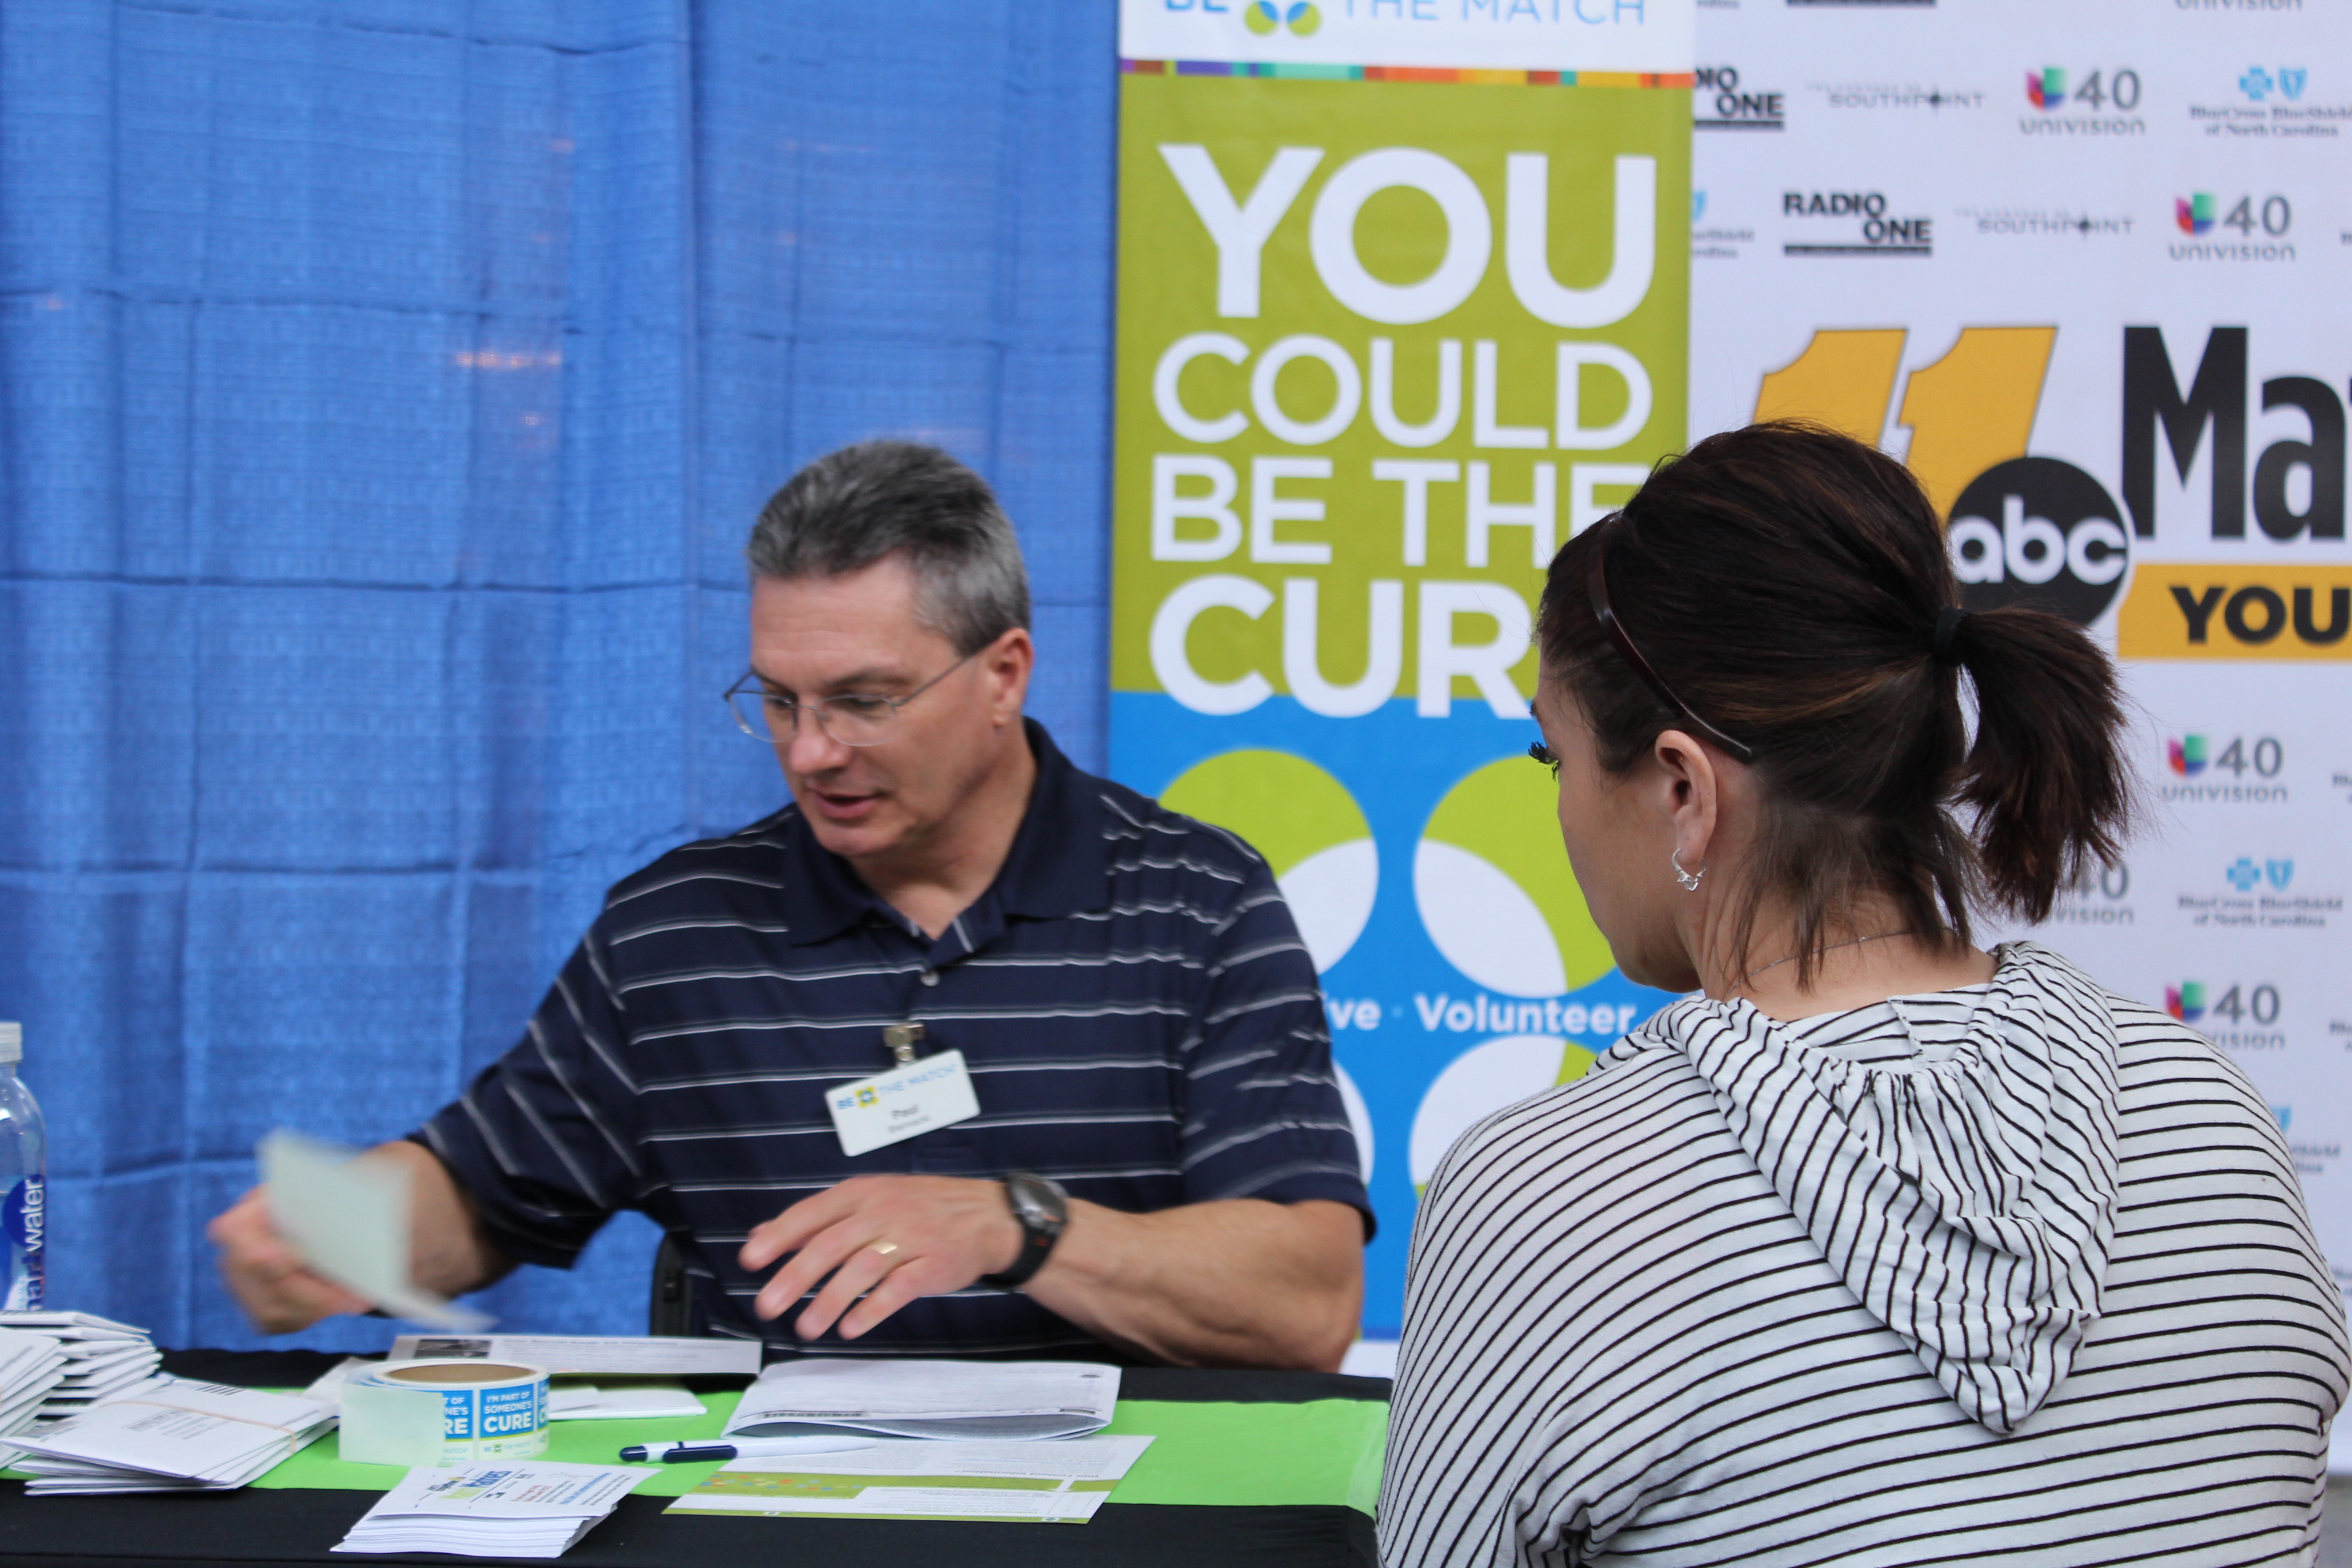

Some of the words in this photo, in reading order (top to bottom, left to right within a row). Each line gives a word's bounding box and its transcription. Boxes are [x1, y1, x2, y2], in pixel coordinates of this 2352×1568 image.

[1717, 93, 1786, 118] ONE
[2074, 68, 2142, 110] 40
[1782, 192, 1886, 217] RADIO
[2222, 194, 2292, 237] 40
[1157, 143, 1657, 329] YOU
[1863, 218, 1933, 244] ONE
[1152, 331, 1653, 451] COULD
[2121, 326, 2352, 544] Ma
[1150, 453, 1333, 564] BE
[1944, 493, 2126, 585] abc
[2169, 585, 2351, 646] YOU
[1149, 573, 1534, 719] CUR
[2215, 737, 2284, 778] 40
[1414, 992, 1637, 1035] Volunteer
[2212, 983, 2281, 1025] 40
[20, 1178, 44, 1252] water
[451, 1397, 466, 1405] OF
[484, 1401, 532, 1414] SOMEONE'S
[486, 1395, 500, 1403] I'M
[500, 1392, 519, 1402] PART
[520, 1391, 531, 1399] OF
[484, 1411, 532, 1433] CURE
